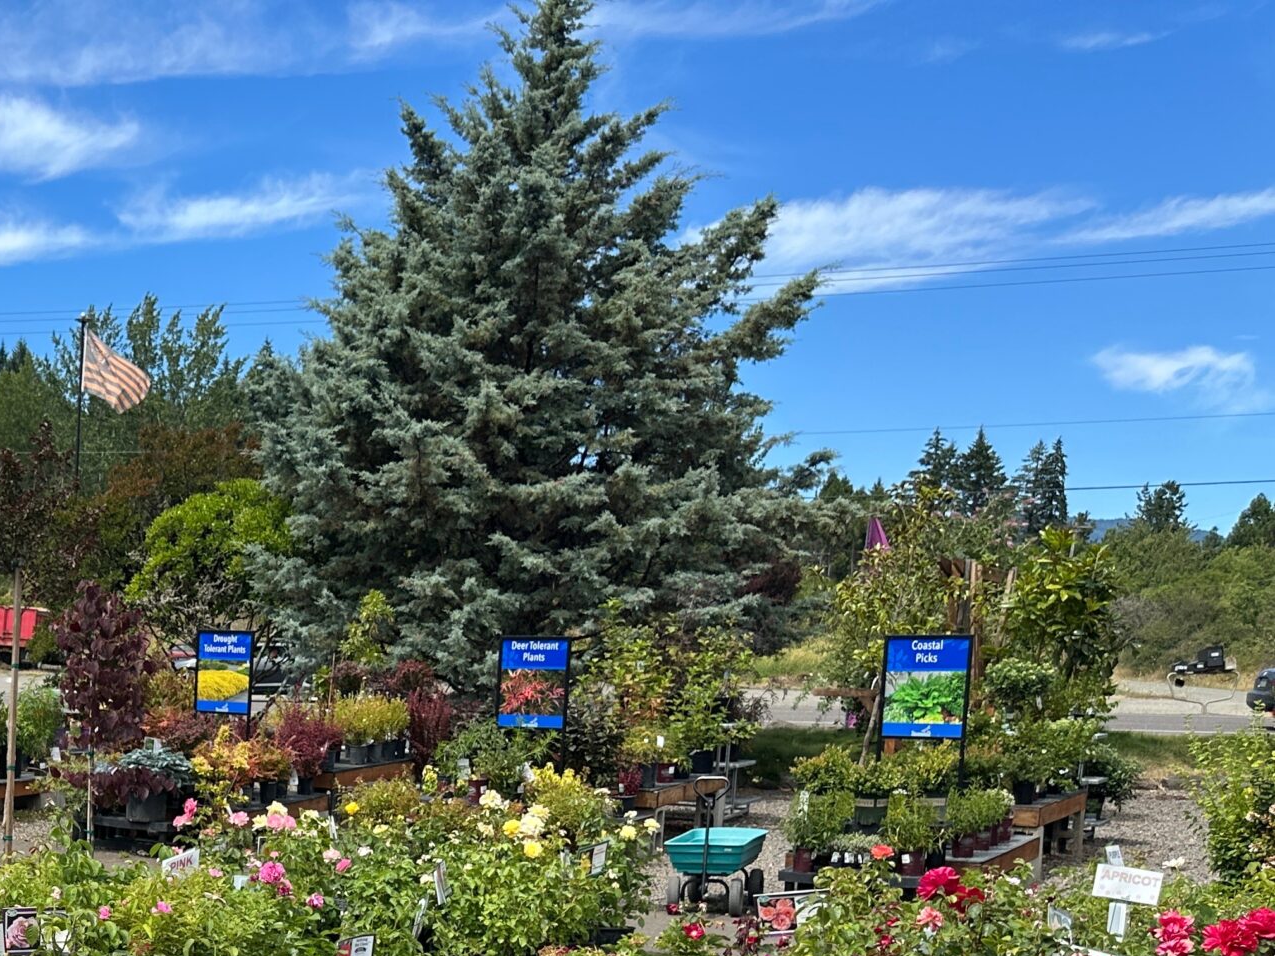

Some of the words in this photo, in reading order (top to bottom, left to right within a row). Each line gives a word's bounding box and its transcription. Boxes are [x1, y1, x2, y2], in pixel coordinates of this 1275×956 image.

[213, 634, 238, 645] Drought
[204, 644, 228, 653] Tolerant
[228, 645, 246, 654] Plants
[511, 641, 529, 650] Deer
[530, 641, 559, 651] Tolerant
[911, 640, 944, 650] Coastal
[523, 652, 545, 662] Plants
[915, 653, 938, 663] Picks
[169, 854, 194, 870] PINK
[1101, 868, 1161, 888] APRICOT
